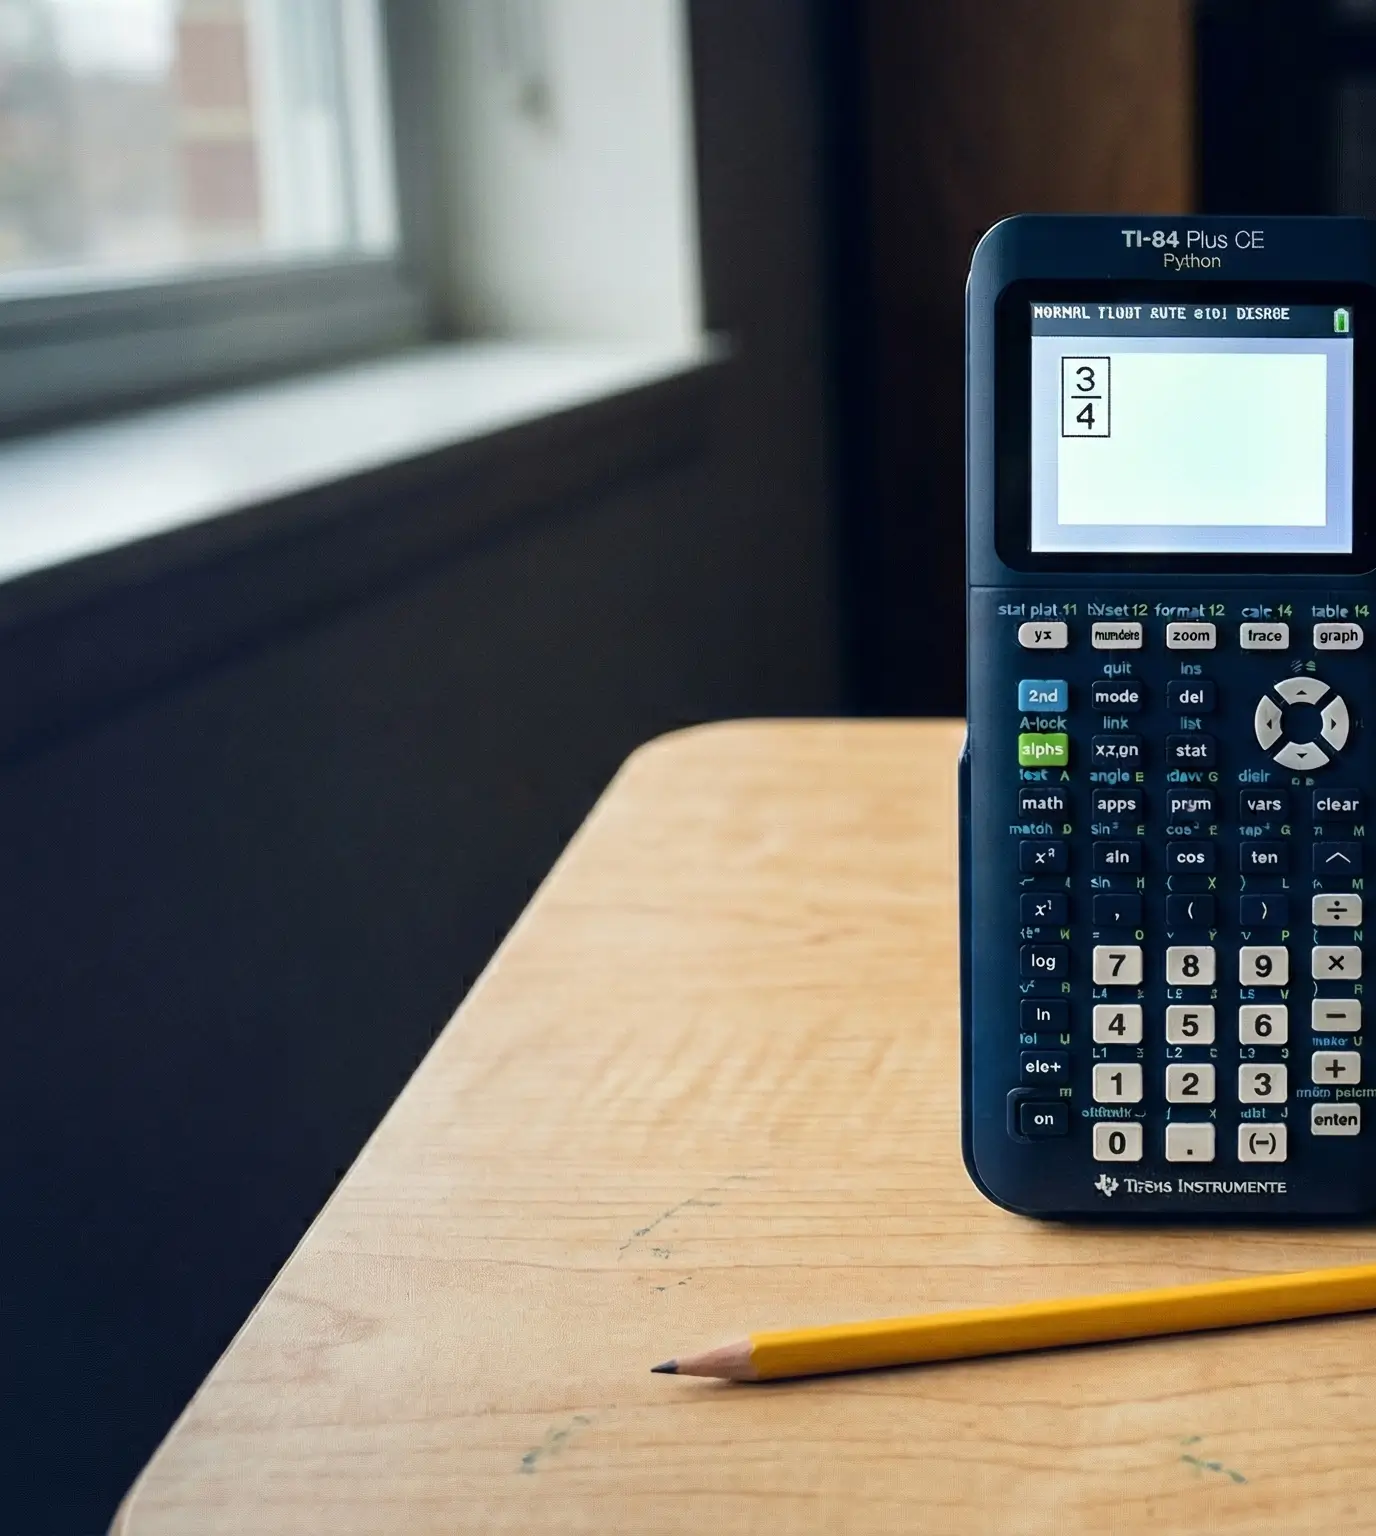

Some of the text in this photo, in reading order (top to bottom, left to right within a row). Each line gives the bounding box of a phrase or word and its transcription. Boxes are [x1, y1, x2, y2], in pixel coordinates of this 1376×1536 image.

[1121, 229, 1265, 249] TI-84 Plus CE
[1163, 252, 1221, 271] Python
[1075, 366, 1096, 392] 3
[1075, 402, 1096, 430] 4
[1209, 604, 1225, 616] 12
[1312, 604, 1349, 618] table
[1172, 630, 1210, 642] zoom
[1320, 629, 1358, 644] graph
[1103, 661, 1132, 678] quit
[1029, 689, 1058, 703] 2nd
[1095, 690, 1139, 703] mode
[1179, 690, 1204, 704] del
[1103, 716, 1129, 730] link
[1176, 743, 1207, 758] stat
[1022, 796, 1064, 810] math
[1097, 798, 1137, 813] apps
[1247, 799, 1282, 811] vars
[1316, 798, 1360, 812] clear
[1137, 825, 1145, 835] E
[1353, 826, 1365, 837] M
[1176, 852, 1206, 865] cos
[1352, 877, 1364, 889] M
[1031, 953, 1057, 971] log
[1108, 954, 1126, 977] 7
[1181, 954, 1200, 977] 8
[1255, 954, 1273, 977] 9
[1108, 1013, 1126, 1036] 4
[1181, 1014, 1199, 1037] 5
[1254, 1014, 1273, 1037] 6
[1166, 1047, 1183, 1058] L2
[1110, 1072, 1123, 1095] 1
[1181, 1073, 1199, 1096] 2
[1254, 1073, 1272, 1096] 3
[1034, 1115, 1054, 1125] on
[1108, 1131, 1126, 1155] 0
